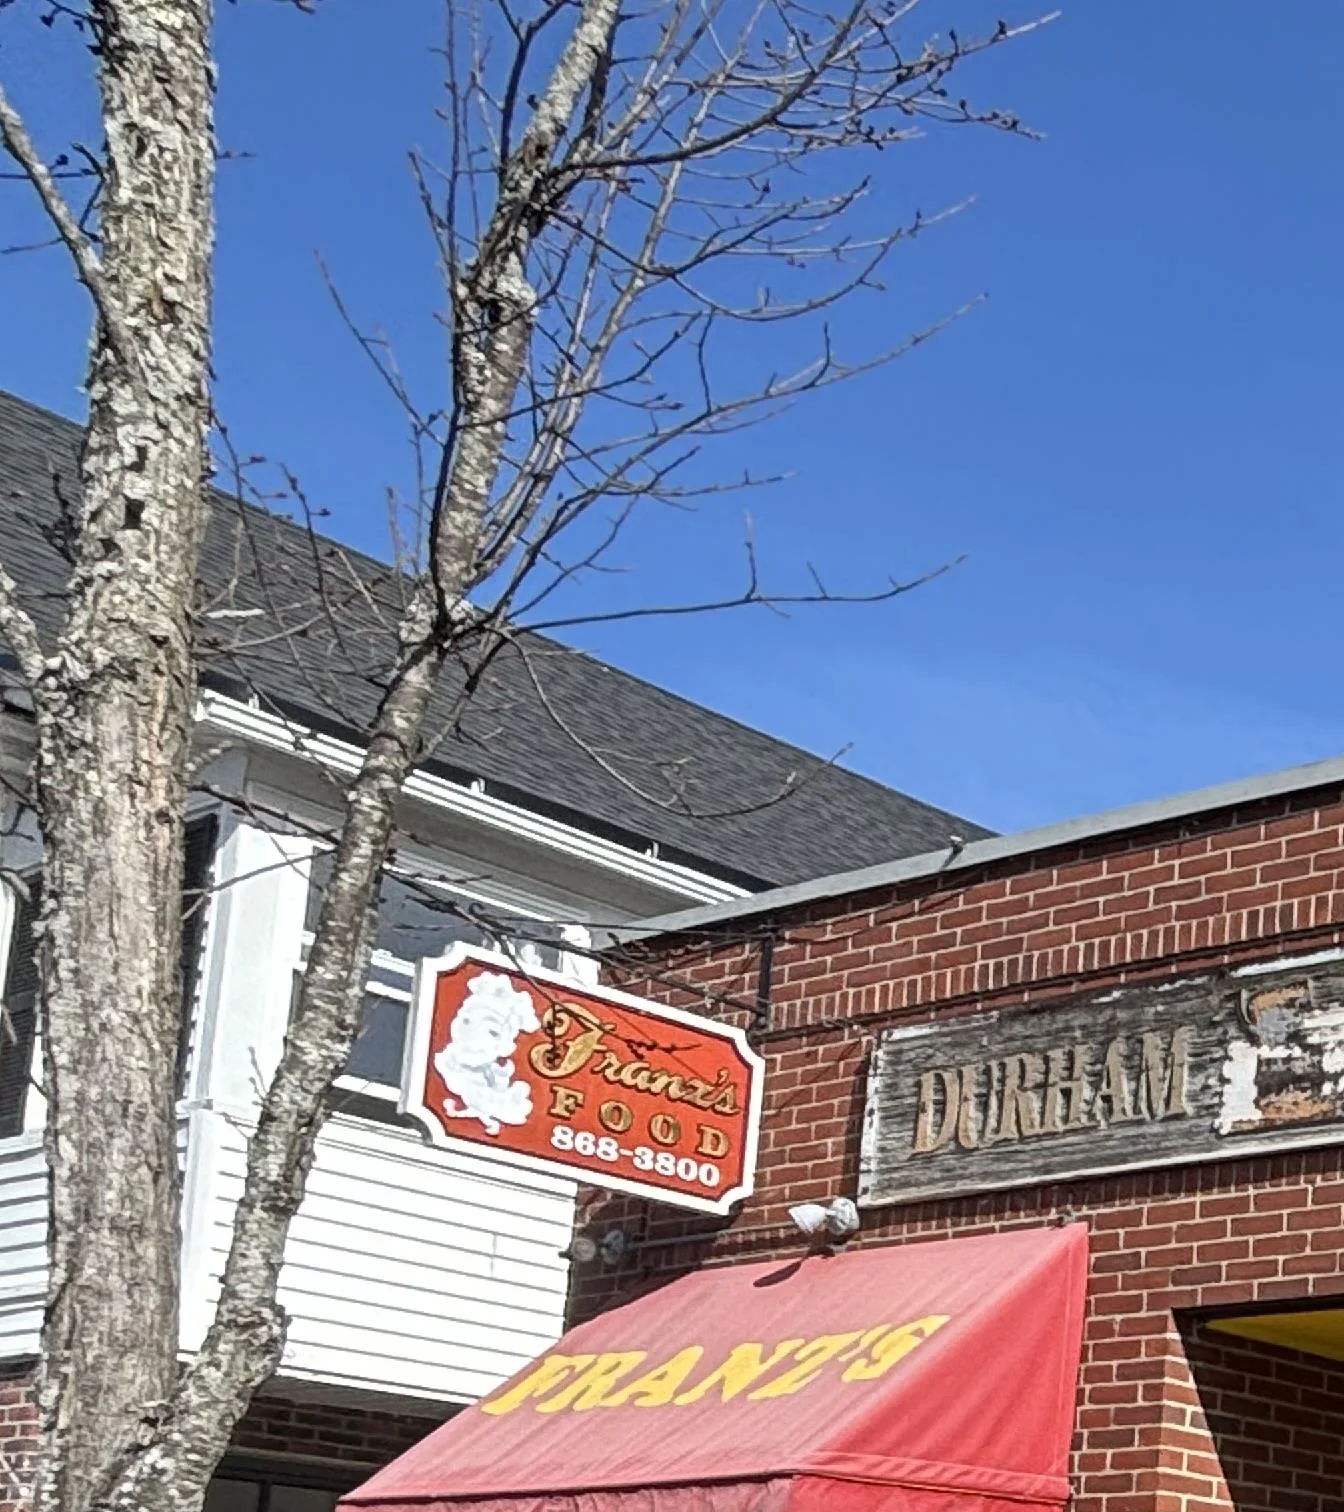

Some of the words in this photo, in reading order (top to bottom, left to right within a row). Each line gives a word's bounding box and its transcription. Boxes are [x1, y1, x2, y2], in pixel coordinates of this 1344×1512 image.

[529, 1001, 741, 1116] Franz's
[914, 1027, 1198, 1152] DURHAM
[547, 1082, 730, 1160] FOOD
[549, 1125, 721, 1188] 868-3800
[480, 1313, 951, 1416] FRANZ'S
